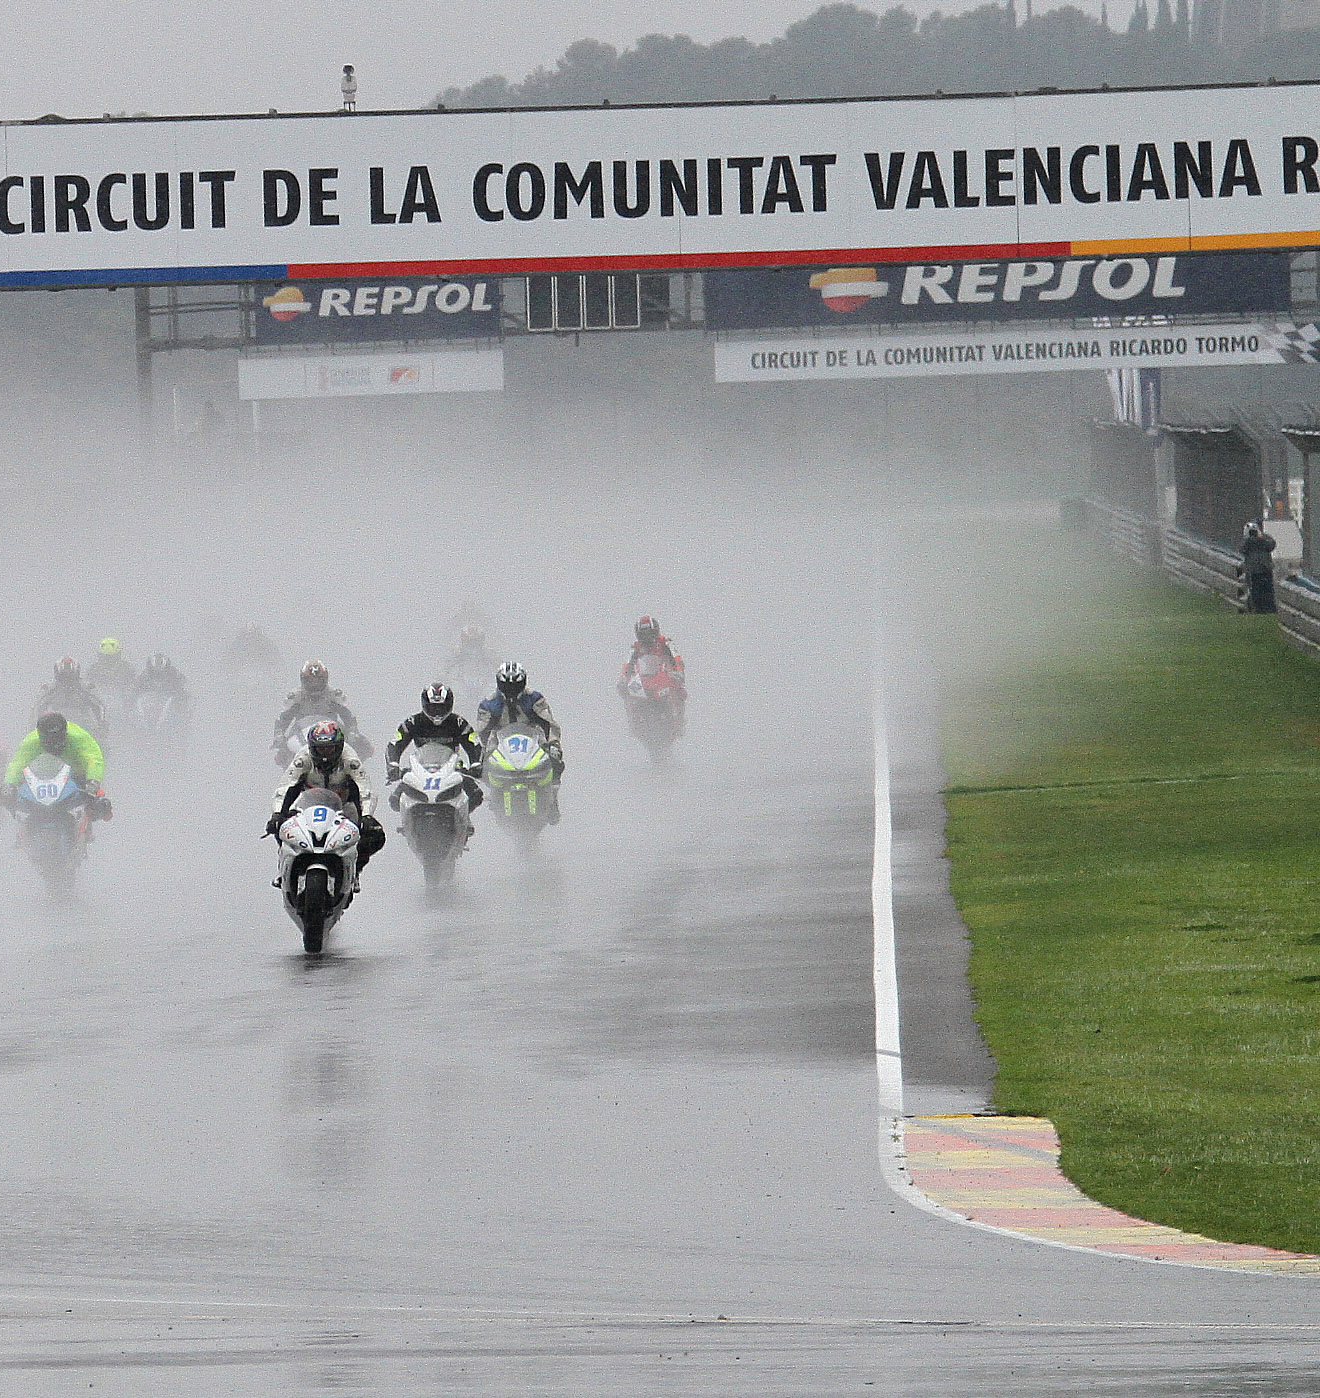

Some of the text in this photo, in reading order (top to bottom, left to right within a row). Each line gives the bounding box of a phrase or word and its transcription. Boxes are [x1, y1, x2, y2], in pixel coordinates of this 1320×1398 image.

[264, 168, 340, 227] DE
[369, 166, 442, 225] LA
[473, 154, 837, 222] COMUNITAT
[865, 140, 1262, 210] VALENCIANA
[1282, 136, 1320, 195] R
[901, 257, 1186, 305] REPSOL
[318, 283, 492, 317] REPSOL
[752, 336, 1260, 369] CIRCUIT DE LA COMUNITAT VALENCIANA RICARDO TORMO
[507, 737, 528, 753] 31
[36, 784, 58, 799] 60
[423, 777, 441, 791] 11
[313, 807, 328, 822] 9
